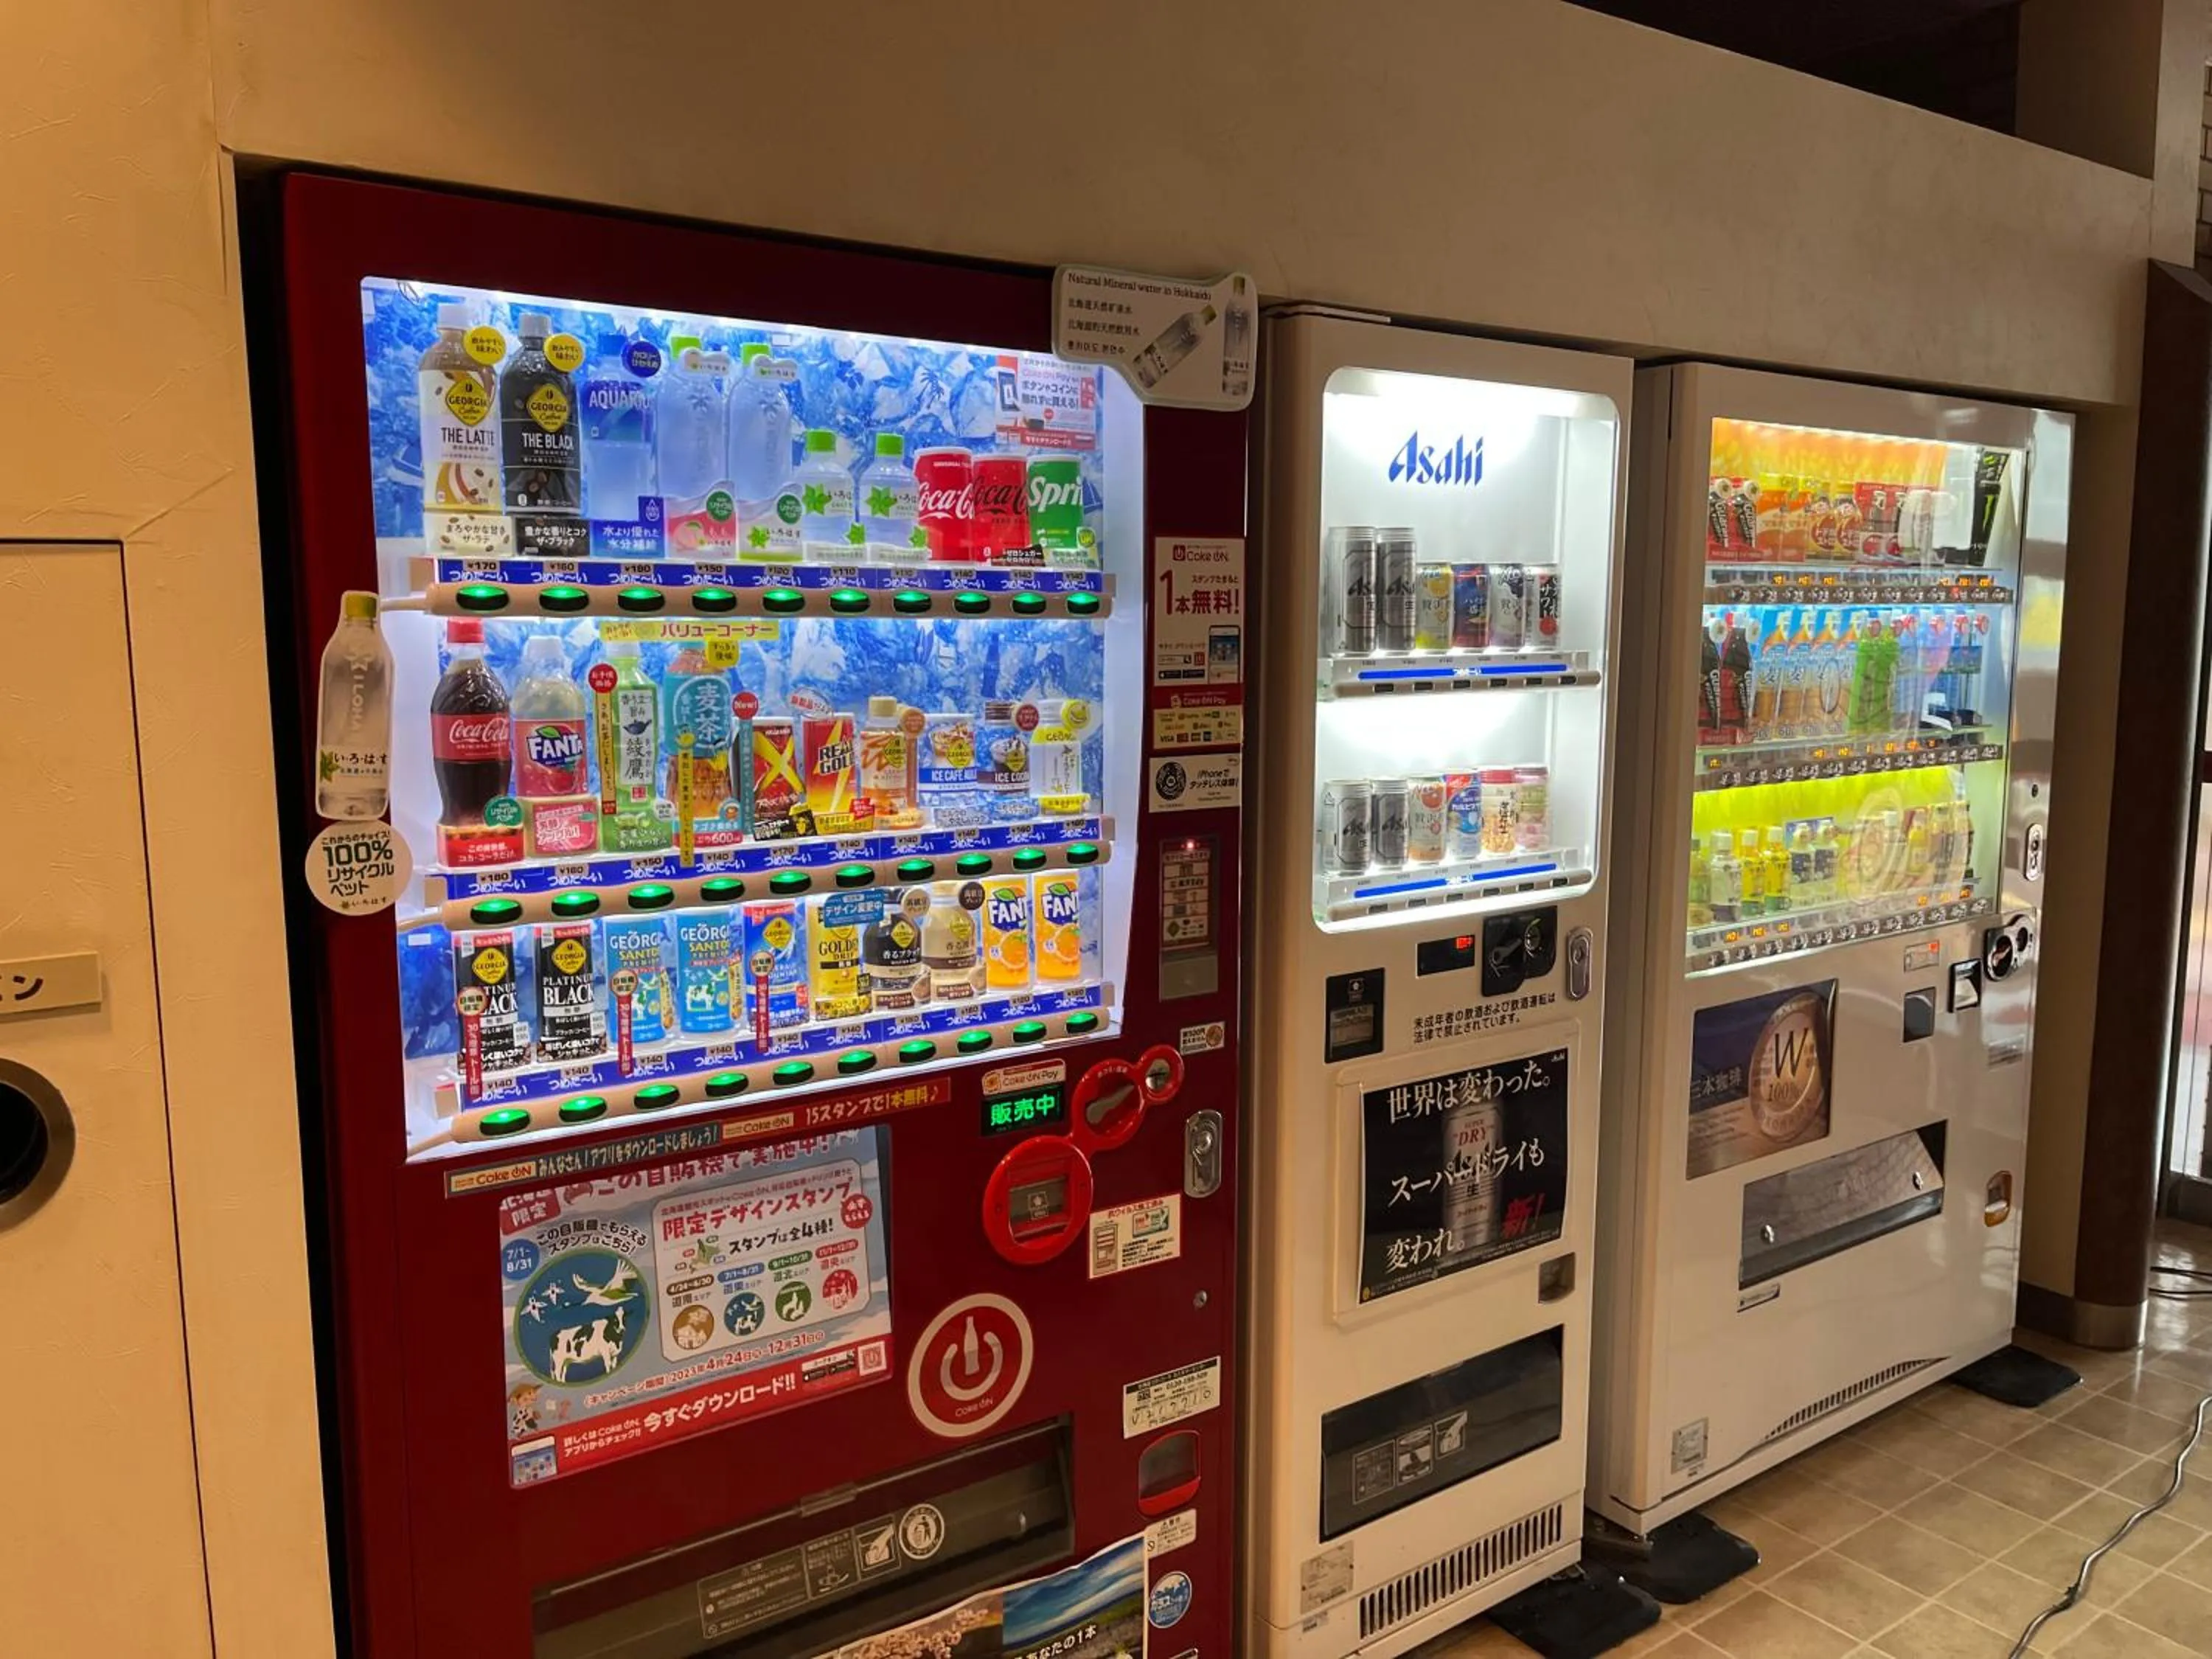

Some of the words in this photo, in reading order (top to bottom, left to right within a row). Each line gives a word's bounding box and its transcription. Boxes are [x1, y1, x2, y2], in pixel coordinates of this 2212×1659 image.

[1068, 273, 1102, 287] Natural
[1104, 277, 1136, 290] Mineral
[1137, 282, 1161, 293] water
[1174, 287, 1211, 301] Hokkaido
[441, 428, 462, 442] THE
[522, 433, 543, 448] THE
[1388, 431, 1483, 486] Asahi
[1187, 551, 1211, 562] Coke
[661, 624, 773, 637] バリューコーナー
[696, 682, 722, 742] 麦茶
[734, 700, 757, 712] New!
[625, 737, 644, 779] 綾鷹
[931, 771, 945, 782] ICE
[995, 773, 1009, 782] ICE
[321, 832, 391, 846] これからのチョイス!
[323, 840, 393, 867] 100%
[327, 863, 395, 882] リサイクル
[330, 879, 369, 897] ペット
[1413, 993, 1556, 1029] 未成年者の飲酒および飲酒運転は
[1413, 1014, 1521, 1043] 法律で禁止されています。
[487, 1079, 512, 1088] ¥140
[1002, 1076, 1024, 1088] Coke
[1042, 1069, 1059, 1082] Pay
[1388, 1060, 1550, 1124] 世界は変わった。
[990, 1093, 1055, 1127] 販売中
[742, 1120, 771, 1134] Coke
[773, 1115, 790, 1128] ON
[1458, 1127, 1487, 1147] DRY
[476, 1170, 509, 1186] Coke
[512, 1165, 532, 1179] ON
[1388, 1138, 1545, 1207] スーパードライも
[512, 1202, 546, 1225] 限定
[664, 1178, 852, 1241] 限定デザインスタンプ
[729, 1219, 833, 1254] スタンプは全4種!
[1386, 1228, 1464, 1275] 変われ。
[507, 1259, 532, 1271] 8/31
[644, 1373, 796, 1433] 今すぐダウンロード!!
